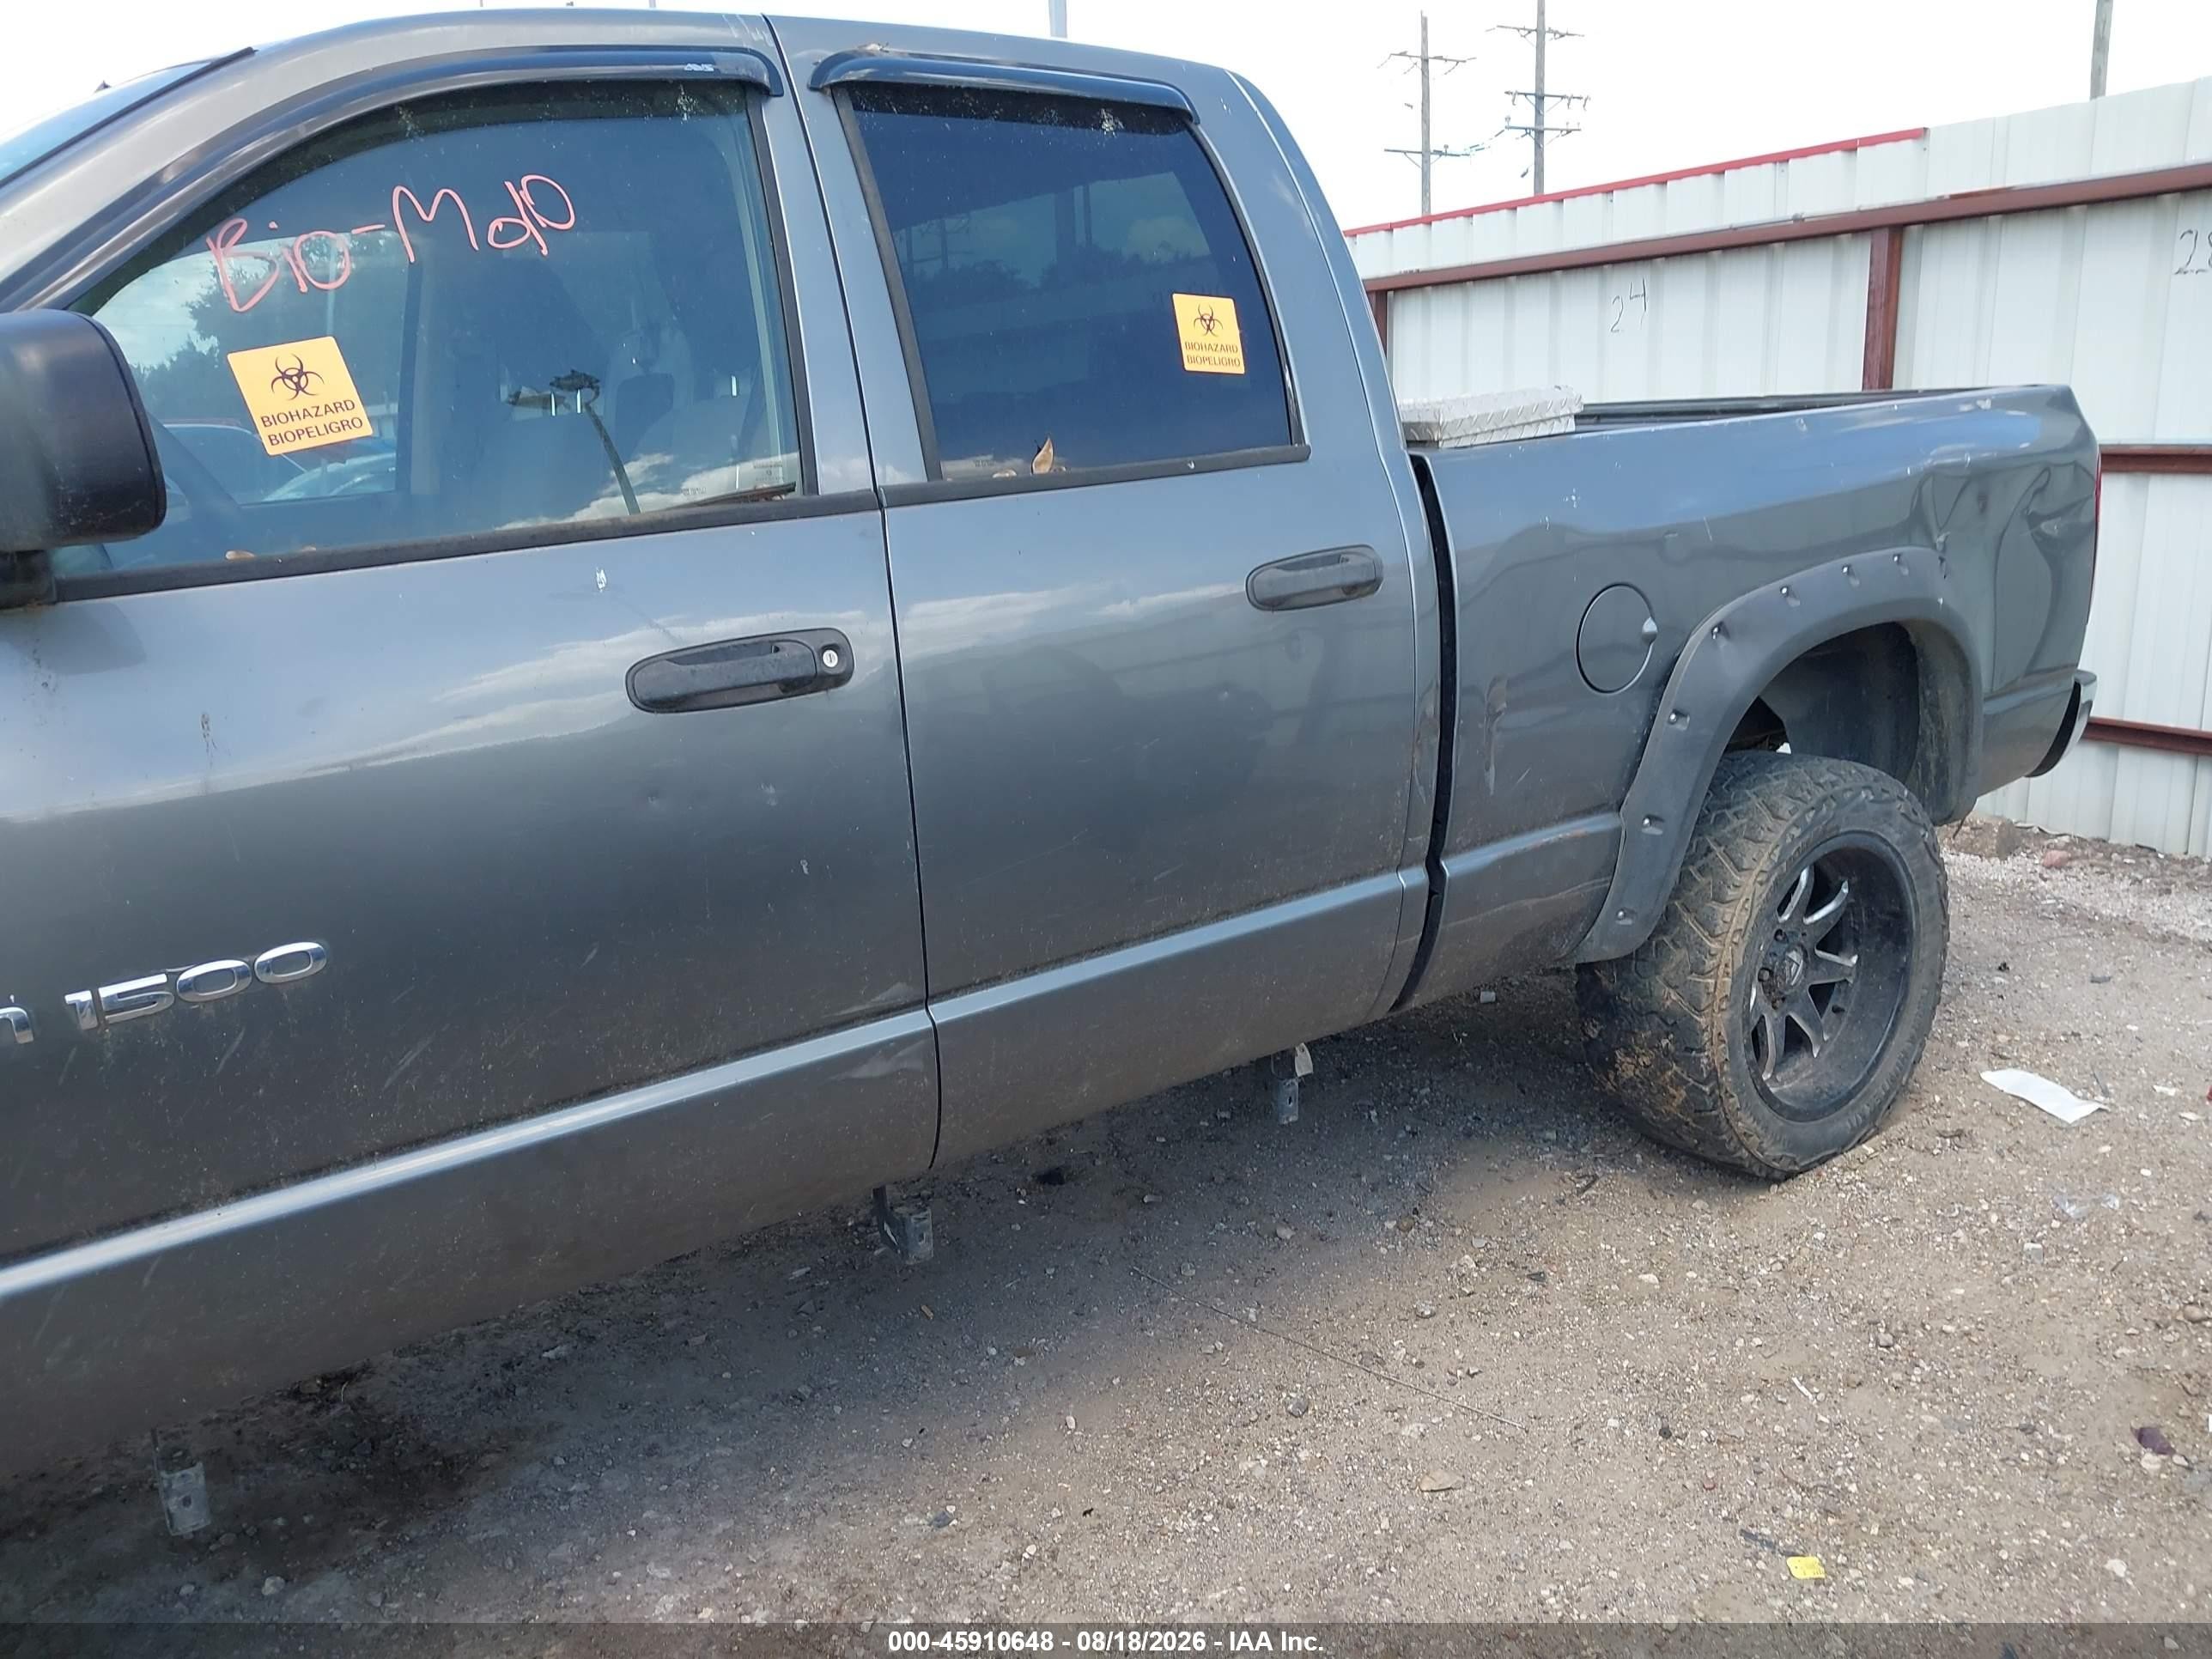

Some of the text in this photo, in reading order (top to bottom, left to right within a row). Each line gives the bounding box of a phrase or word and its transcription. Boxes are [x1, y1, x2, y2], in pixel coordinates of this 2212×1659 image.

[2174, 228, 2212, 275] 2
[1610, 277, 1647, 333] 24
[1184, 341, 1238, 354] BIOHAZARD
[1186, 355, 1241, 368] BIOPELIGRO
[260, 399, 356, 428] BIOHAZARD
[267, 416, 363, 447] BIOPELIGRO
[64, 941, 327, 1030] 1500
